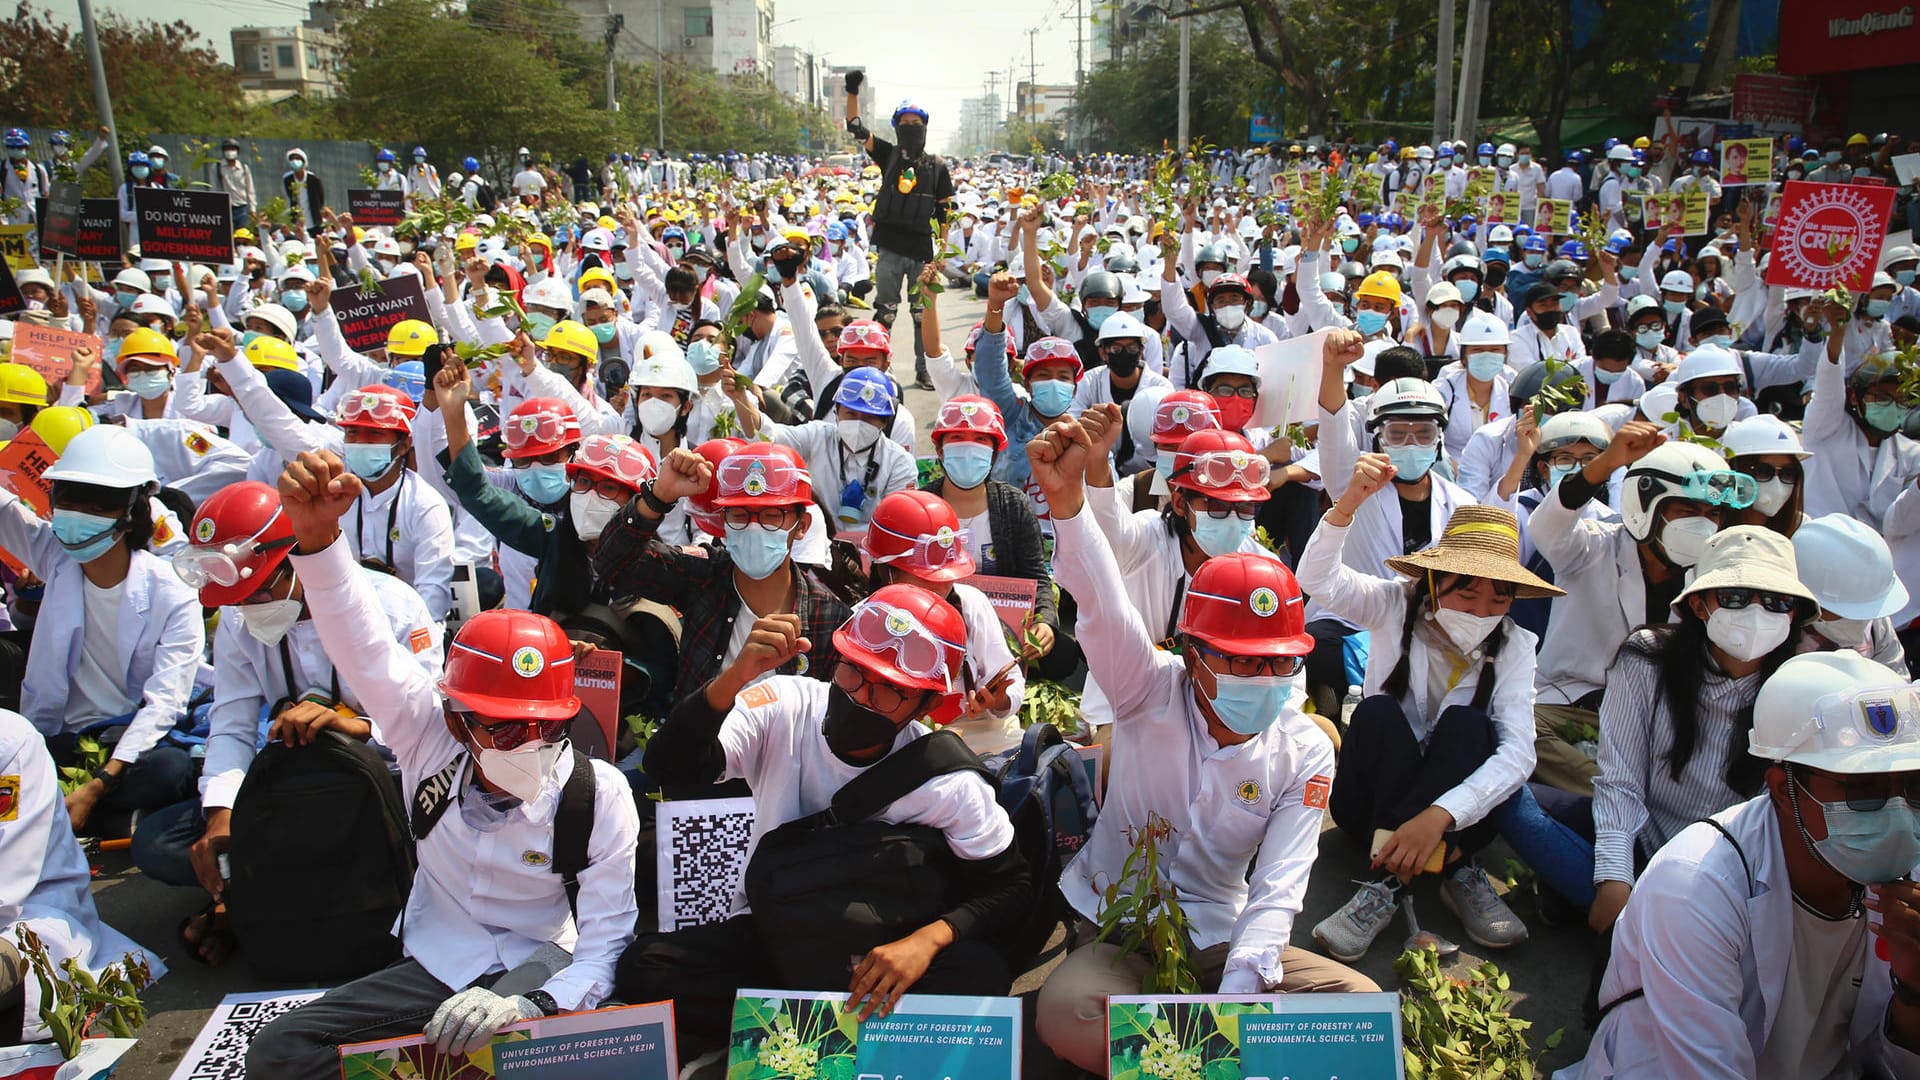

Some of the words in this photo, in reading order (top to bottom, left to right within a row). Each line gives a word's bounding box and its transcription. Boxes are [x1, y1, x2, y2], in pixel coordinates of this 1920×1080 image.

[172, 197, 192, 208] WE
[83, 218, 113, 229] WANT
[145, 211, 161, 221] DO
[164, 213, 186, 223] NOT
[188, 214, 222, 226] WANT
[156, 226, 213, 240] MILITARY
[142, 241, 230, 257] GOVERNMENT
[336, 310, 347, 320] O
[349, 303, 376, 318] NOT
[377, 296, 414, 311] WANT
[343, 311, 407, 334] MILITARY
[30, 331, 65, 343] HELP
[69, 337, 87, 348] US
[991, 600, 1032, 609] OLUTION
[865, 1021, 914, 1031] UNIVERSITY
[916, 1023, 928, 1031] OF
[930, 1023, 973, 1032] FORESTRY
[974, 1025, 993, 1033] AND
[1245, 1023, 1295, 1031] UNIVERSITY
[1297, 1023, 1309, 1031] OF
[1311, 1022, 1353, 1031] FORESTRY
[1355, 1021, 1373, 1030] AND
[501, 1045, 556, 1059] UNIVERSITY
[559, 1043, 572, 1051] OF
[574, 1036, 621, 1049] FORESTRY
[623, 1033, 642, 1042] AND
[864, 1034, 934, 1044] ENVIRONMENTAL
[936, 1036, 975, 1046] SCIENCE,
[978, 1037, 1003, 1046] YEZIN
[1246, 1034, 1316, 1044] ENVIRONMENTAL
[1319, 1034, 1358, 1043] SCIENCE,
[1361, 1034, 1385, 1042] YEZIN
[503, 1054, 580, 1070] ENVIRONMENTAL
[583, 1047, 626, 1059] SCIENCE,
[629, 1043, 655, 1053] YEZIN
